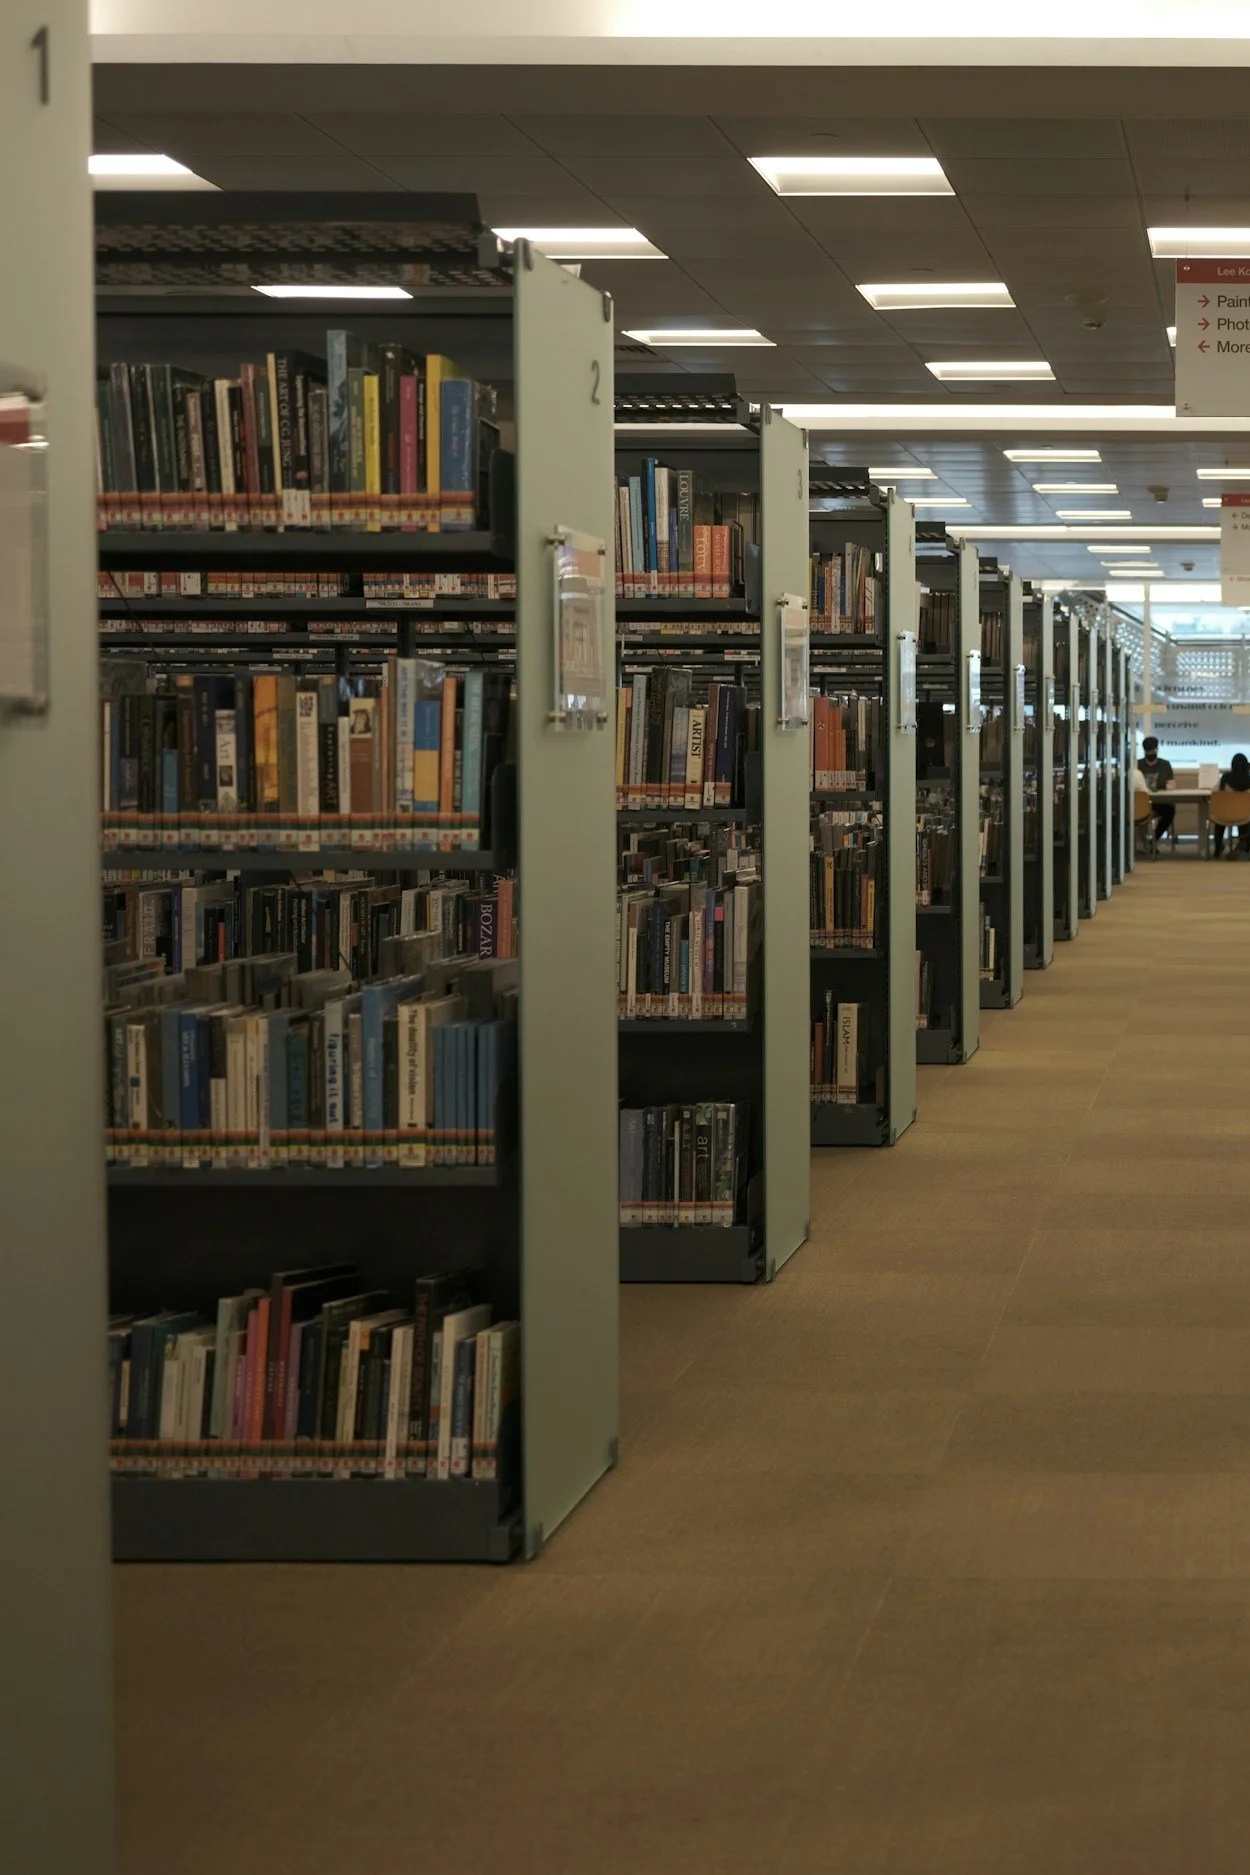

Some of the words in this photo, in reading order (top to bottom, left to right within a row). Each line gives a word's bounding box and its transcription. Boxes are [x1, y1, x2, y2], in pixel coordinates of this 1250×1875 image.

[31, 26, 49, 105] 1
[1217, 267, 1236, 277] Lee
[276, 358, 287, 380] THE
[278, 381, 287, 402] ART
[591, 360, 600, 405] 2
[279, 403, 289, 417] OF
[280, 438, 291, 467] JUNG
[679, 474, 689, 521] LOUVRE
[696, 538, 705, 572] LOUV
[219, 737, 232, 760] Art
[691, 720, 701, 759] ARTIST
[326, 781, 338, 805] ART
[480, 904, 493, 956] BOZAR
[408, 1010, 417, 1024] The
[115, 1028, 124, 1044] ART
[406, 1026, 417, 1057] duality
[842, 1016, 850, 1044] ISLAM
[327, 1033, 340, 1084] figuring
[408, 1059, 417, 1068] of
[328, 1087, 340, 1098] it
[408, 1070, 418, 1095] vision
[328, 1102, 339, 1124] out
[682, 1123, 691, 1149] ART
[697, 1136, 710, 1159] art
[416, 1292, 428, 1314] THE
